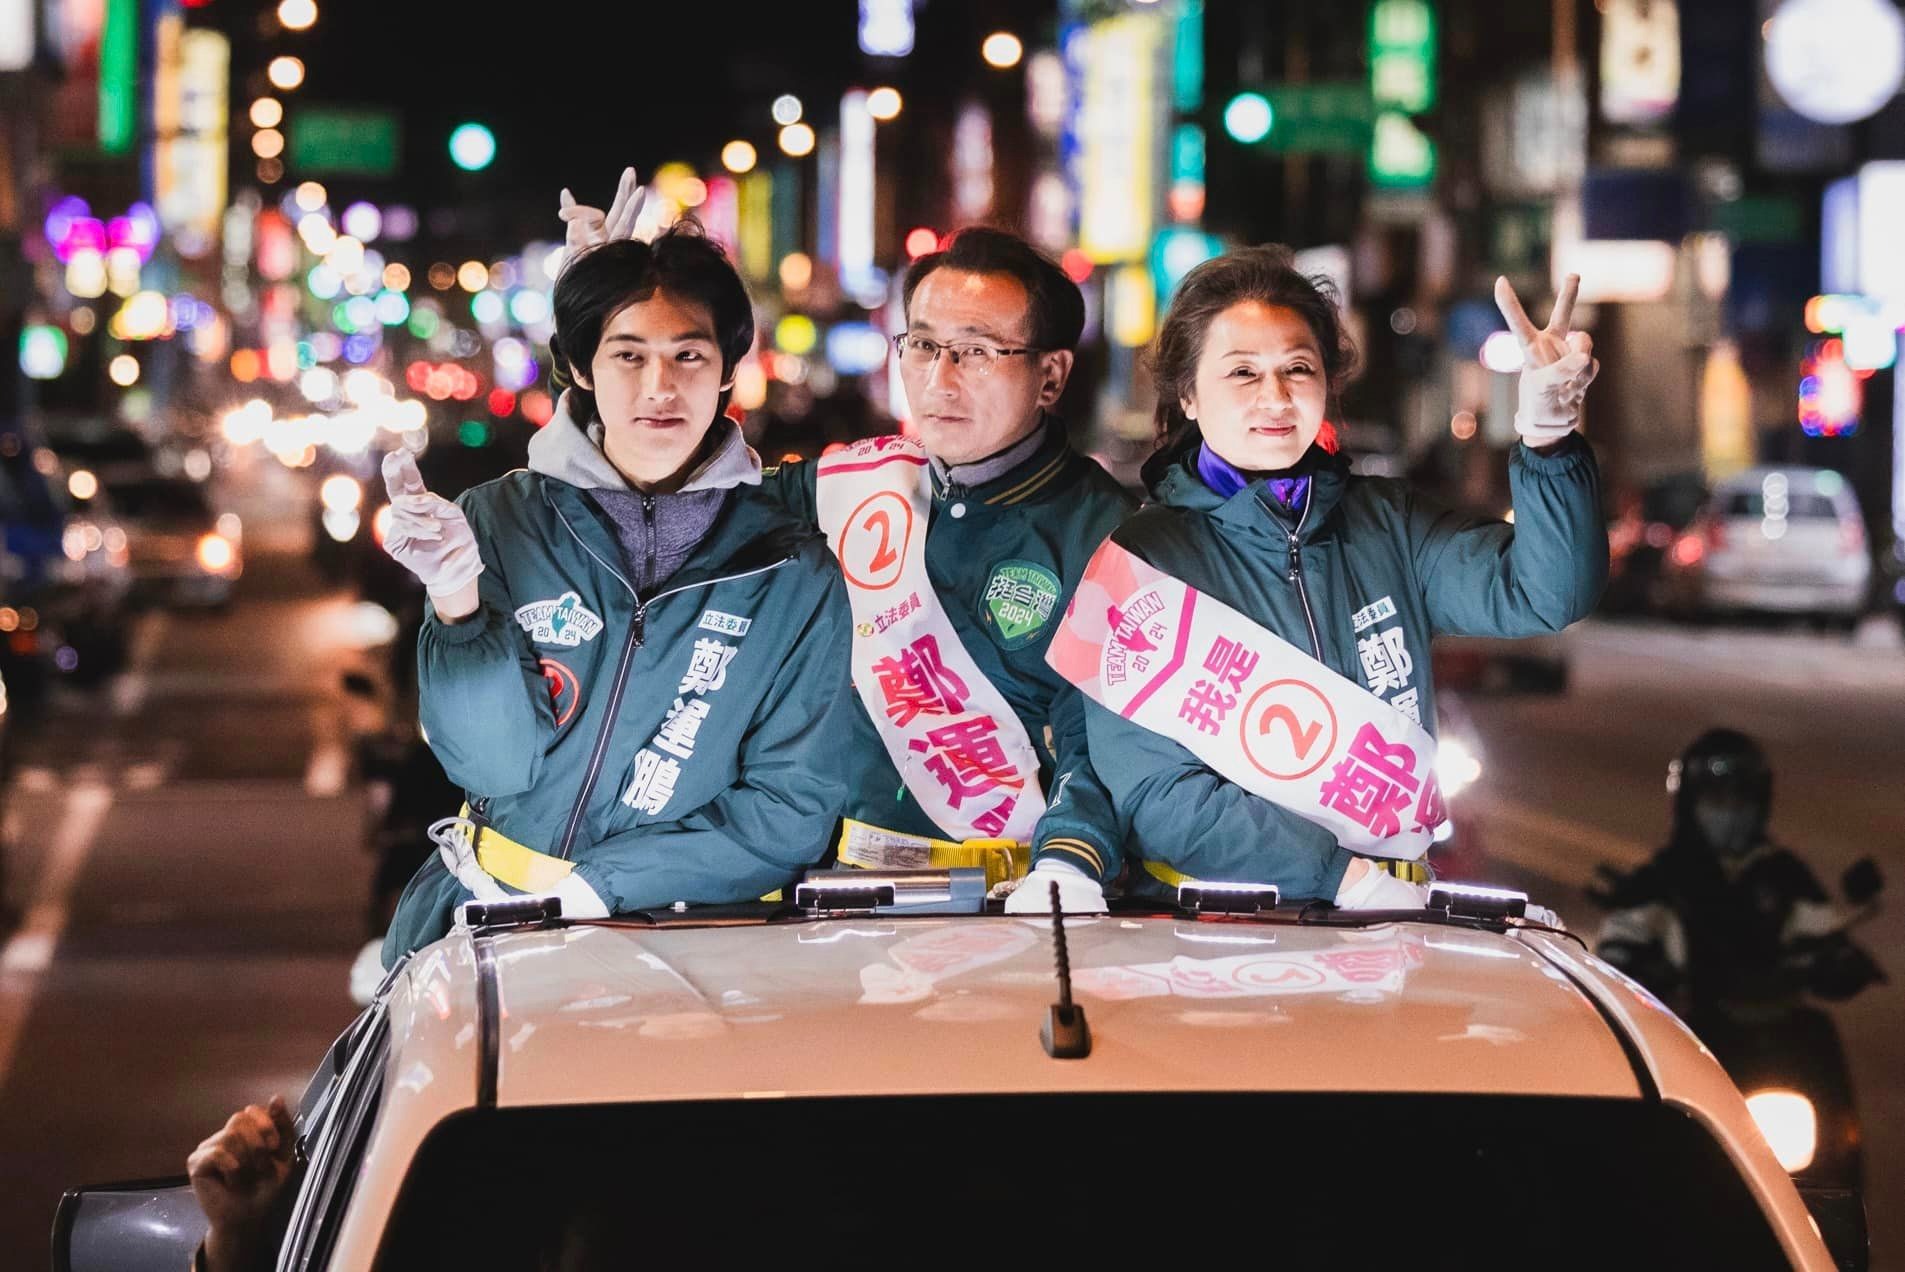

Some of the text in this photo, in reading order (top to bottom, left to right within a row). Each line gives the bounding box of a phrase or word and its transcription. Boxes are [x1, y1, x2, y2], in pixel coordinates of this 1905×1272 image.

[520, 606, 598, 636] TEAM TAIWAN
[702, 613, 751, 635] 立法委員
[875, 592, 922, 634] 立法委員
[998, 602, 1034, 627] 2024
[1354, 601, 1390, 631] 法委員
[537, 626, 577, 641] 20 24
[1107, 591, 1165, 686] TEAM TAIWAN
[1132, 623, 1168, 674] 20 24
[1178, 635, 1261, 737] 我是
